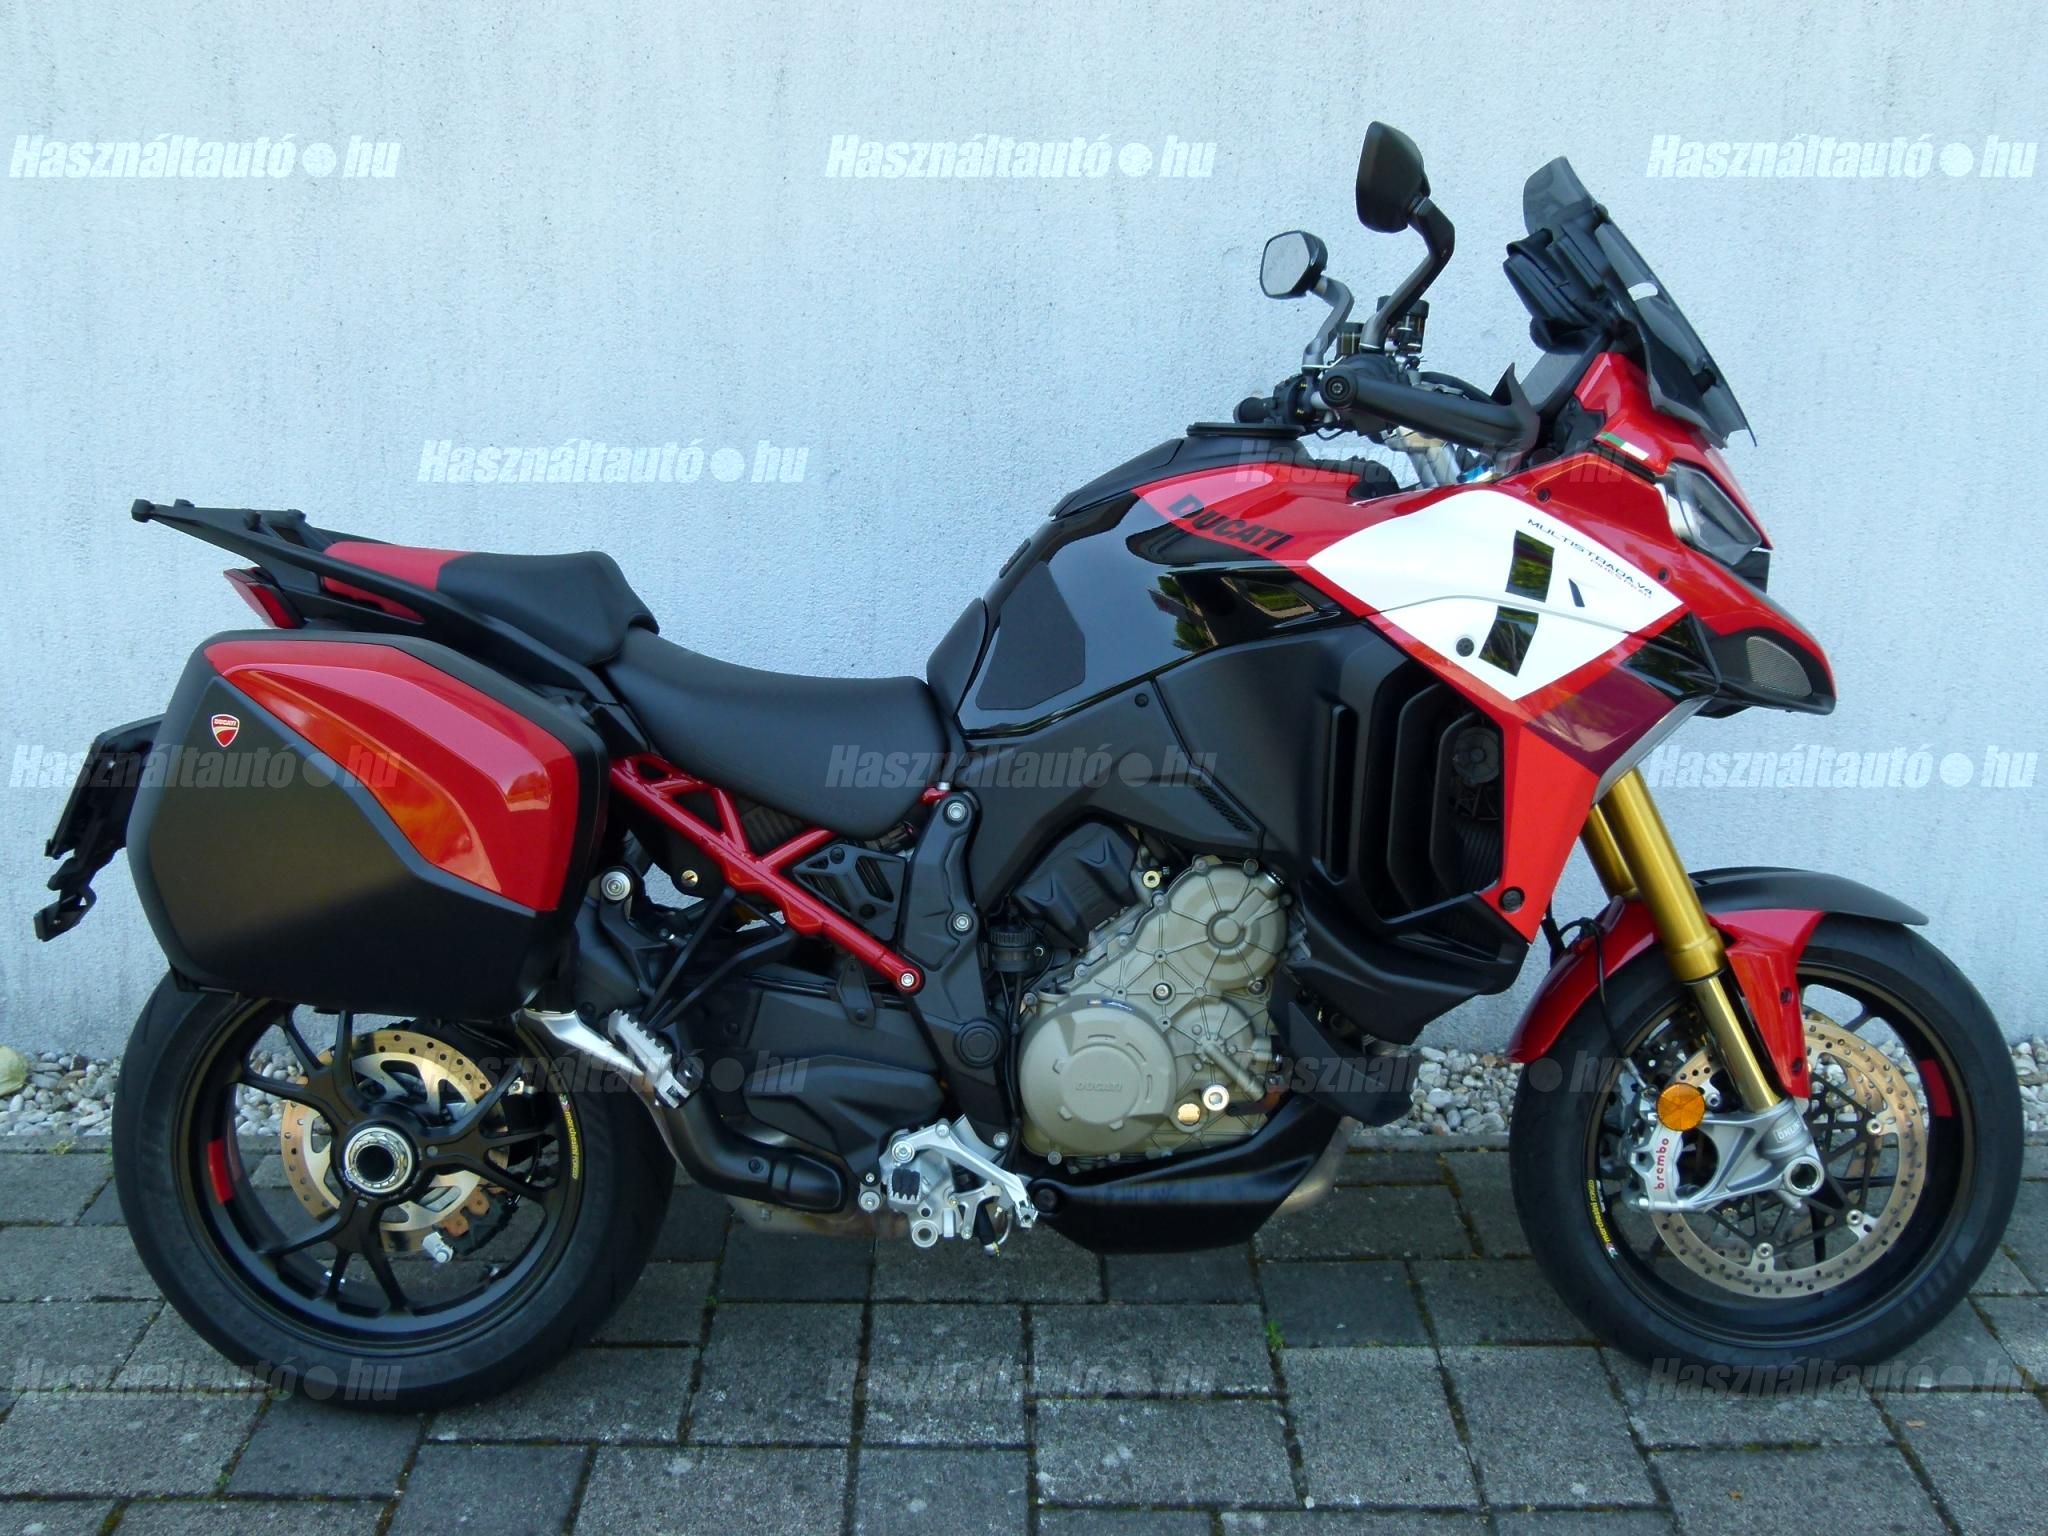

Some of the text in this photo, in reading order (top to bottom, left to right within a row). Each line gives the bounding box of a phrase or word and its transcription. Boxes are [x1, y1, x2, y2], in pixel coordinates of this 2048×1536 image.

[1168, 494, 1294, 551] DUCATI
[1527, 518, 1634, 583] MULTISTRADA
[1654, 1137, 1669, 1190] brembo
